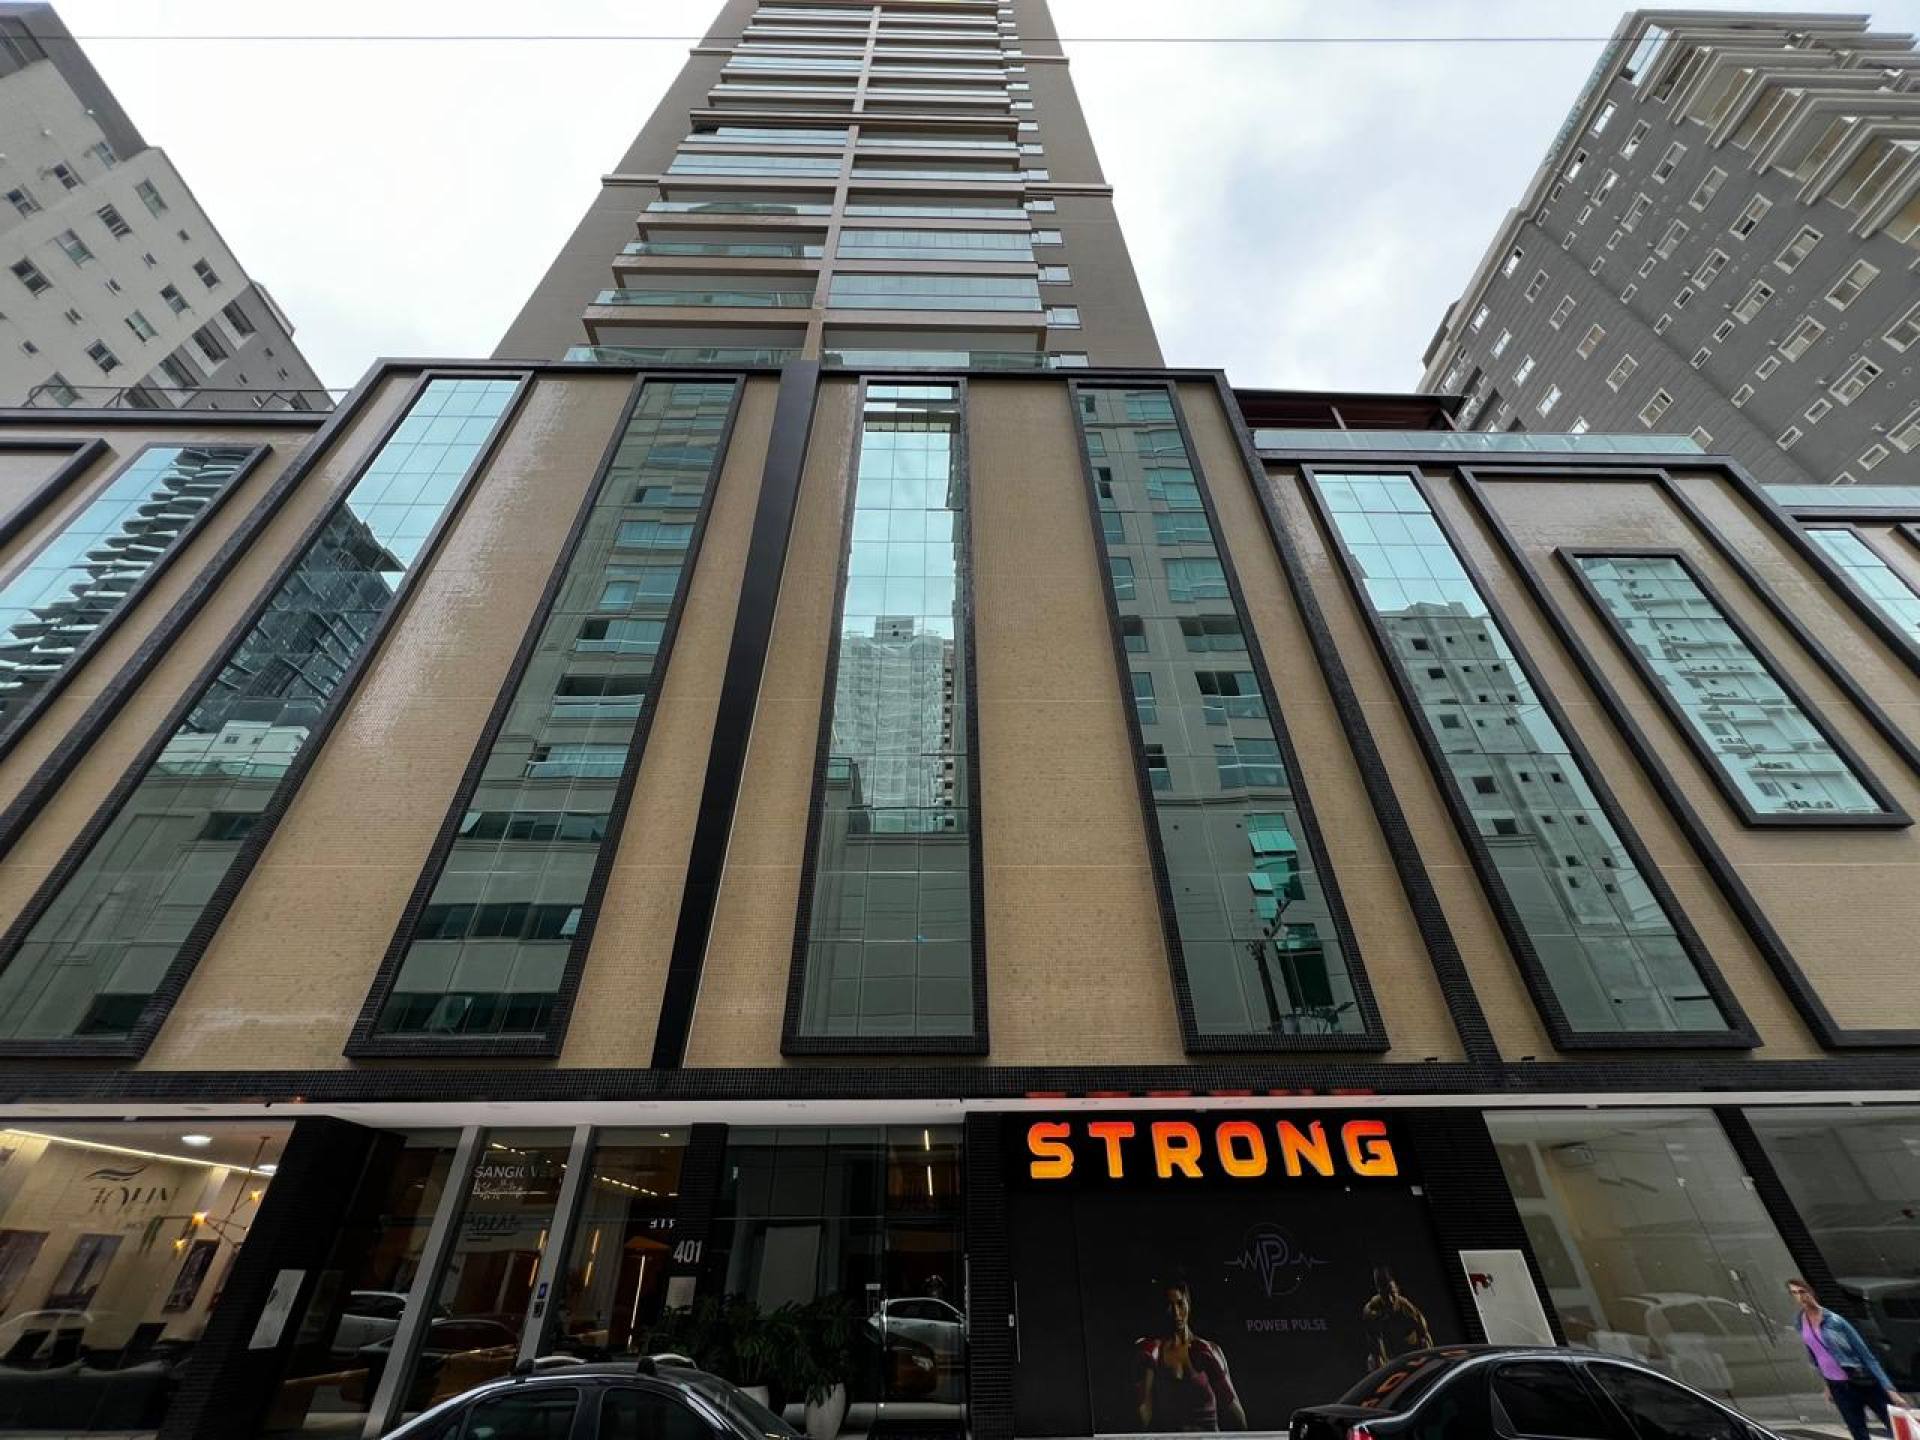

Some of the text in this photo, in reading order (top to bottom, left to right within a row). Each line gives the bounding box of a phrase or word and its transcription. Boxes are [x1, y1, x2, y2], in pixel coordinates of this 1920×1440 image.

[1027, 1120, 1399, 1179] STRONG
[673, 1240, 703, 1263] 401
[1246, 1318, 1329, 1332] POWER PULSE
